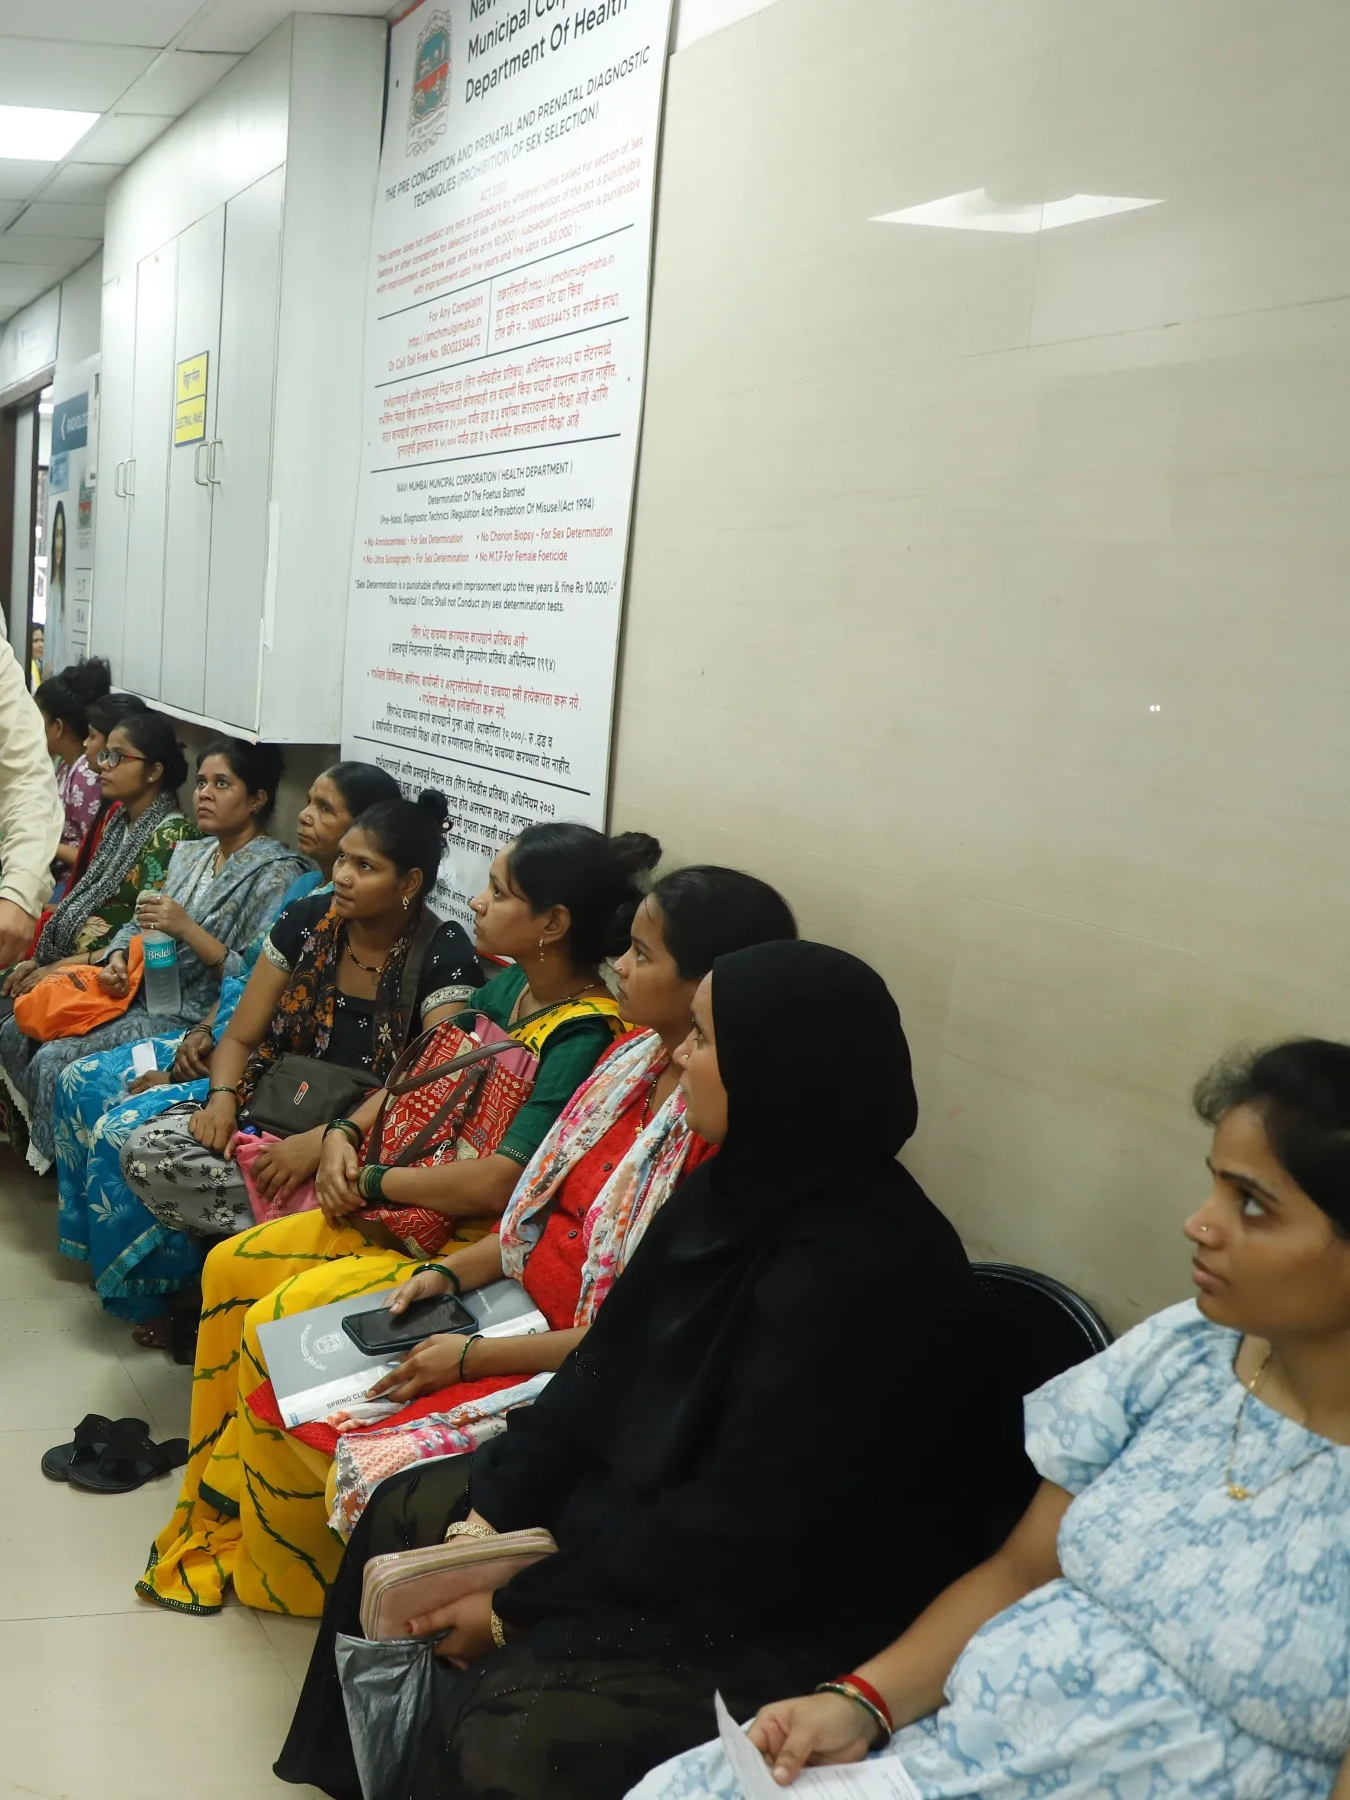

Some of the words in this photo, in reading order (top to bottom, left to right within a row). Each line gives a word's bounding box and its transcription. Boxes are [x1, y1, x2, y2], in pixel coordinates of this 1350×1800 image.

[468, 0, 530, 63] Municipal
[465, 36, 545, 104] Department
[550, 17, 570, 51] Of
[385, 184, 396, 199] THE
[397, 177, 410, 194] PRE
[411, 155, 454, 188] CONCEPTION
[456, 143, 473, 164] AND
[475, 121, 513, 150] PRENATAL
[516, 109, 535, 131] AND
[537, 86, 583, 120] PRENATAL
[587, 45, 649, 95] DIAGNOSTIC
[413, 175, 455, 207] TECHNIQUES
[511, 140, 523, 158] OF
[525, 131, 541, 152] SEX
[428, 310, 437, 322] For
[439, 307, 450, 318] Any
[451, 295, 483, 314] Complaint
[408, 479, 428, 490] MUMBAI
[456, 471, 496, 485] CORPORATION
[501, 467, 524, 480] HEALTH
[525, 461, 568, 477] DEPARTMENT
[427, 494, 462, 505] Determination
[463, 490, 470, 501] Of
[471, 490, 481, 500] The
[482, 488, 501, 499] Foetus
[502, 486, 525, 498] Banned
[403, 513, 427, 525] Diagnostic
[428, 510, 449, 521] Technics
[480, 506, 492, 516] And
[526, 502, 534, 514] Of
[367, 537, 374, 547] No
[410, 534, 418, 544] For
[418, 534, 427, 544] Sex
[428, 534, 463, 544] Determination
[480, 531, 489, 541] No
[489, 530, 512, 541] Chorion
[513, 529, 534, 542] Biopsy
[540, 527, 551, 539] For
[552, 527, 564, 539] Sex
[566, 525, 612, 538] Determination
[479, 551, 487, 561] No
[503, 550, 513, 561] For
[514, 550, 536, 561] Female
[537, 549, 567, 561] Foeticide
[366, 579, 397, 589] Determination
[398, 581, 402, 589] is
[402, 581, 405, 589] a
[406, 580, 431, 589] punishable
[431, 579, 450, 590] offence
[451, 580, 462, 590] with
[463, 581, 501, 592] imprisonment
[502, 582, 516, 593] upto
[517, 581, 534, 592] three
[535, 583, 552, 594] years
[554, 581, 559, 592] &
[561, 580, 574, 593] fine
[575, 581, 583, 593] Rs
[398, 595, 416, 607] Hospital
[420, 595, 434, 606] Clinic
[434, 596, 446, 606] Shall
[447, 598, 456, 607] not
[457, 596, 479, 607] Conduct
[480, 599, 491, 610] any
[492, 600, 502, 608] sex
[503, 600, 545, 610] determination
[547, 601, 564, 611] tests.
[326, 1394, 352, 1409] SPRING
[352, 1388, 368, 1401] CLIP
